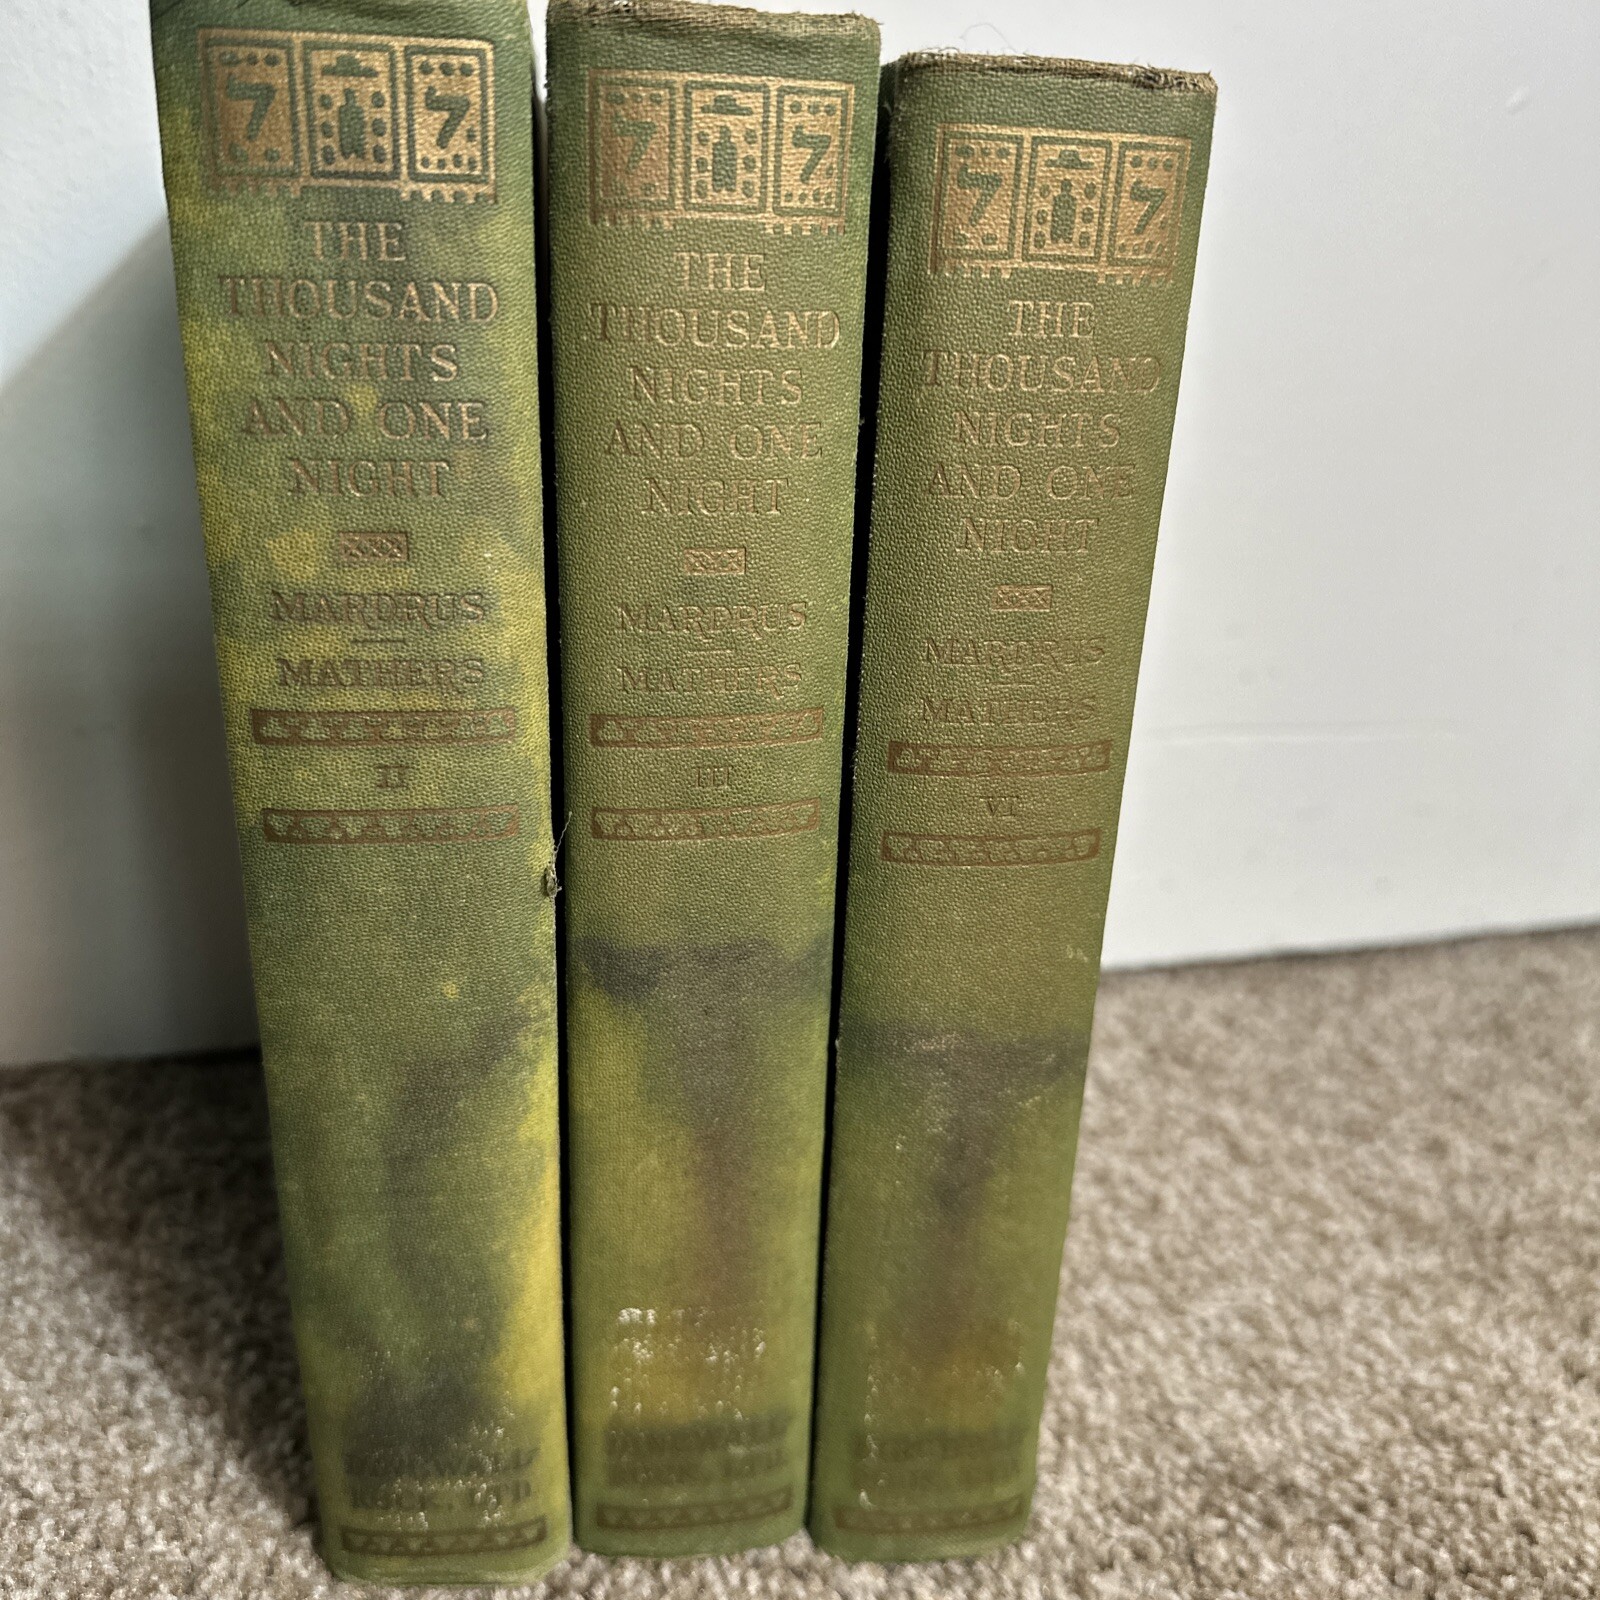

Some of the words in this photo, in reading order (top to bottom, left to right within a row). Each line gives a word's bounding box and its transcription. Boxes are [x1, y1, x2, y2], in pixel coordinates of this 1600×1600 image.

[303, 220, 407, 262] THE
[676, 252, 766, 292] THE
[218, 275, 500, 325] THOUSAND
[1008, 300, 1096, 339] THE
[592, 302, 840, 350] THOUSAND
[266, 340, 459, 382] NIGHTS
[920, 348, 1162, 394] THOUSAND
[630, 366, 803, 405] NIGHTS
[243, 399, 352, 438] AND
[377, 400, 489, 441] ONE
[604, 420, 704, 460] AND
[729, 422, 824, 460] ONE
[953, 411, 1121, 448] NIGHTS
[288, 457, 453, 499] NIGHT
[644, 478, 788, 516] NIGHT
[930, 465, 1022, 500] AND
[1045, 464, 1136, 500] ONE
[956, 517, 1099, 554] NIGHT
[271, 590, 486, 632] MARDRUS
[616, 601, 808, 642] MARDRUS
[276, 659, 486, 700] MATHERS
[616, 664, 802, 700] MATHERS
